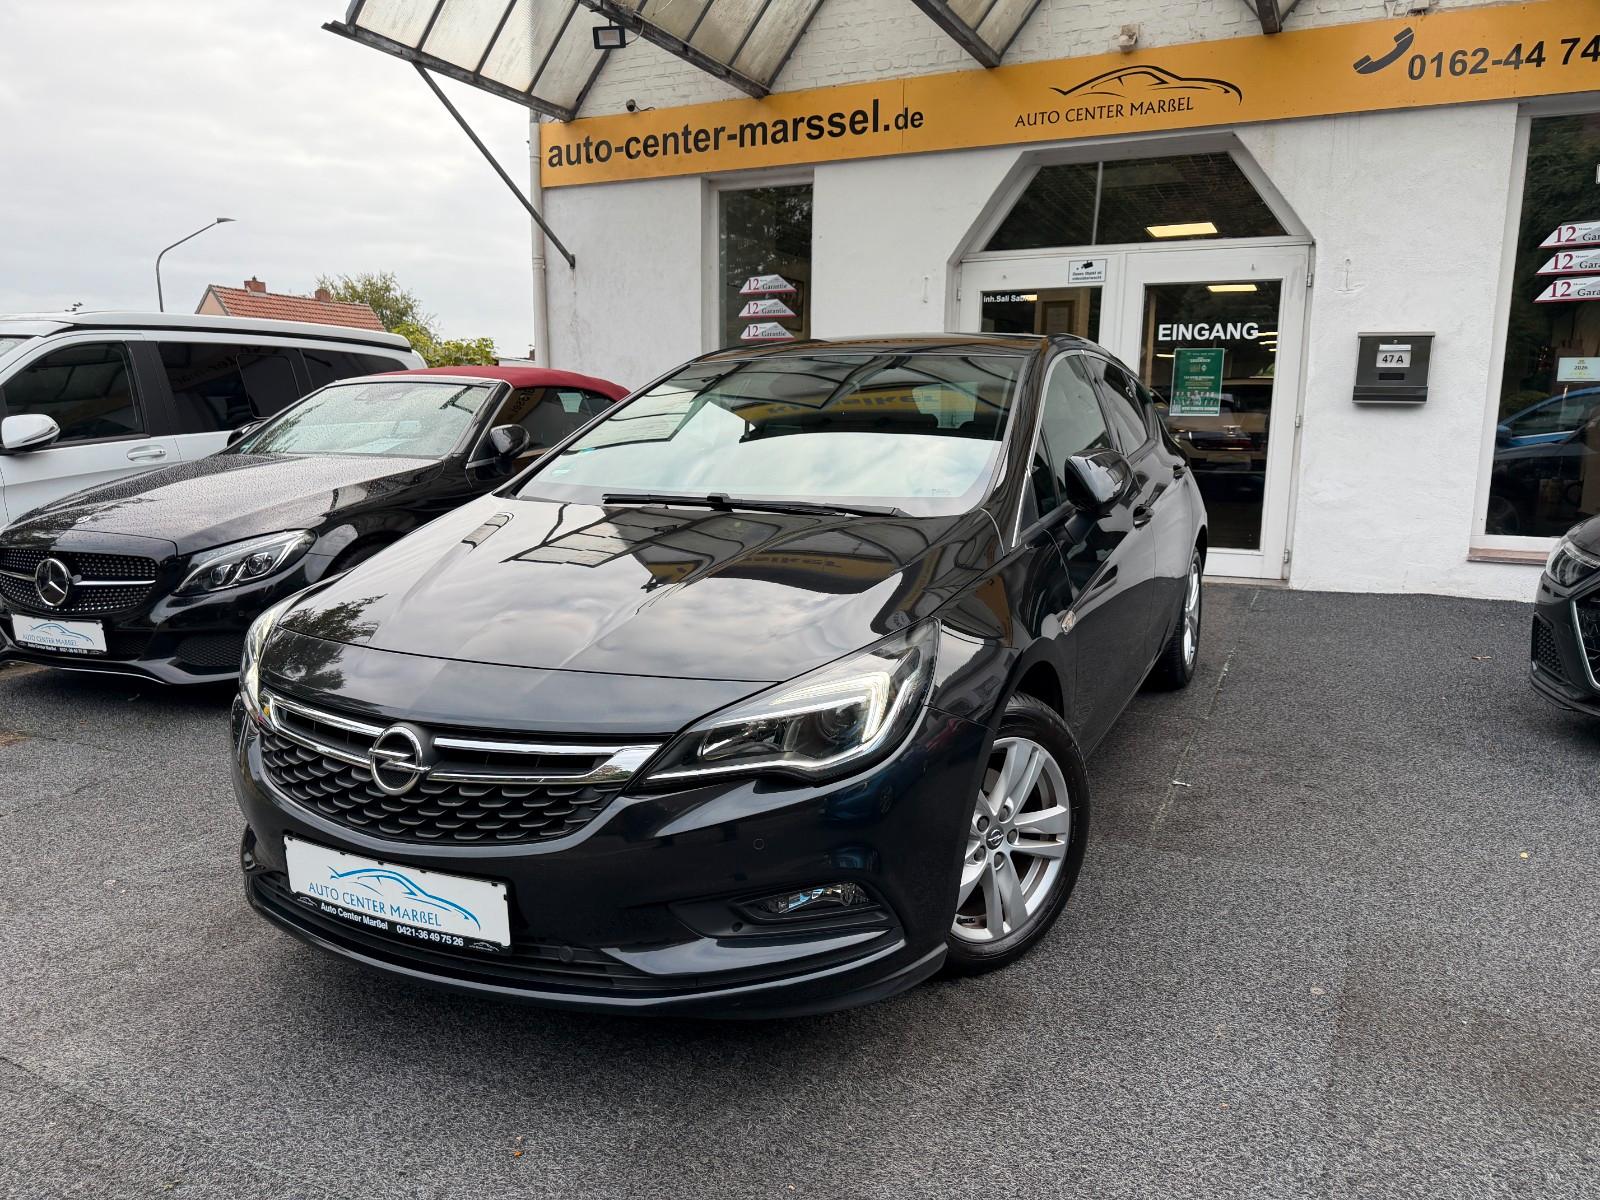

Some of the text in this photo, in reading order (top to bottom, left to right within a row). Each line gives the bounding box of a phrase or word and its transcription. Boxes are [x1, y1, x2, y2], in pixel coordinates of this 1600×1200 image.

[1408, 35, 1600, 81] 0162-44 74
[1014, 110, 1060, 127] AUTO
[1065, 103, 1124, 122] CENTER
[548, 98, 924, 167] auto-center-marssel.de
[1554, 226, 1576, 243] 12
[1552, 253, 1573, 269] 12
[747, 279, 759, 290] 12
[1549, 281, 1571, 297] 12
[747, 303, 759, 314] 12
[747, 326, 759, 337] 12
[1158, 322, 1259, 341] EINGANG
[1382, 354, 1404, 363] 47 A
[308, 882, 339, 901] AUTO
[342, 892, 386, 915] CENTER
[320, 902, 337, 915] Auto
[337, 907, 362, 923] Center
[396, 924, 464, 947] 0421-36 49 75 26
